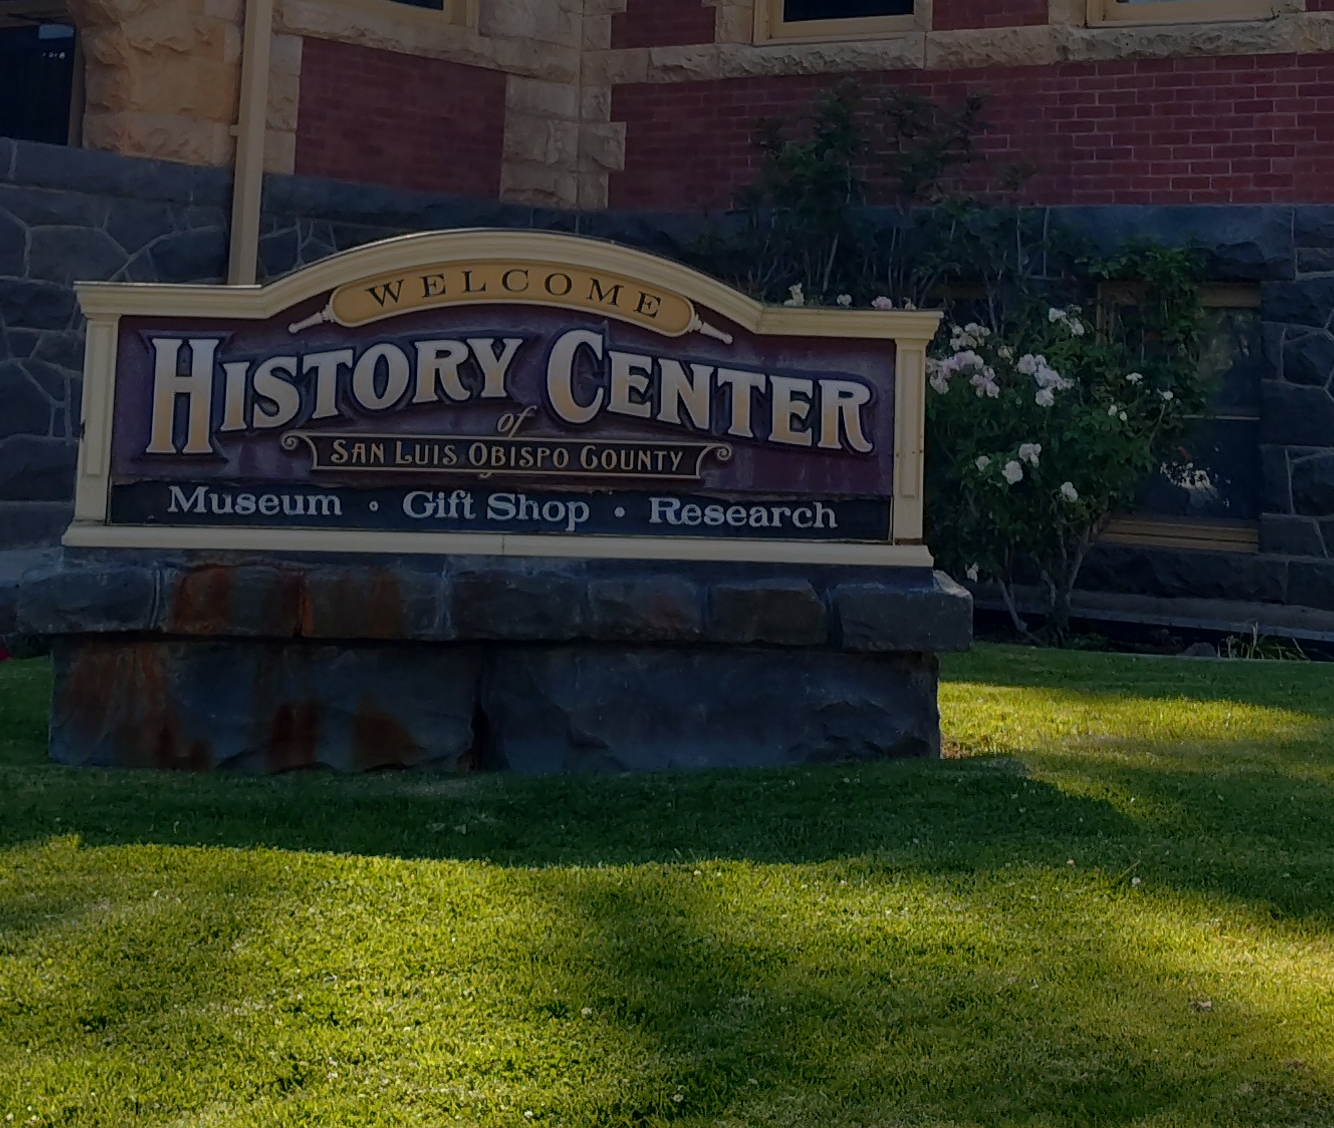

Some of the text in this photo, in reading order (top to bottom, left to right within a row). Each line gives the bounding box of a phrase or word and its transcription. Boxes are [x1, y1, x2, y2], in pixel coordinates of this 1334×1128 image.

[364, 267, 664, 319] WELCOME
[145, 328, 874, 456] HISTORY CENTER
[495, 406, 537, 436] of
[329, 439, 685, 472] SAN LUIS OBISPO COUNTY
[167, 484, 839, 532] Museum Gift Shop Research
